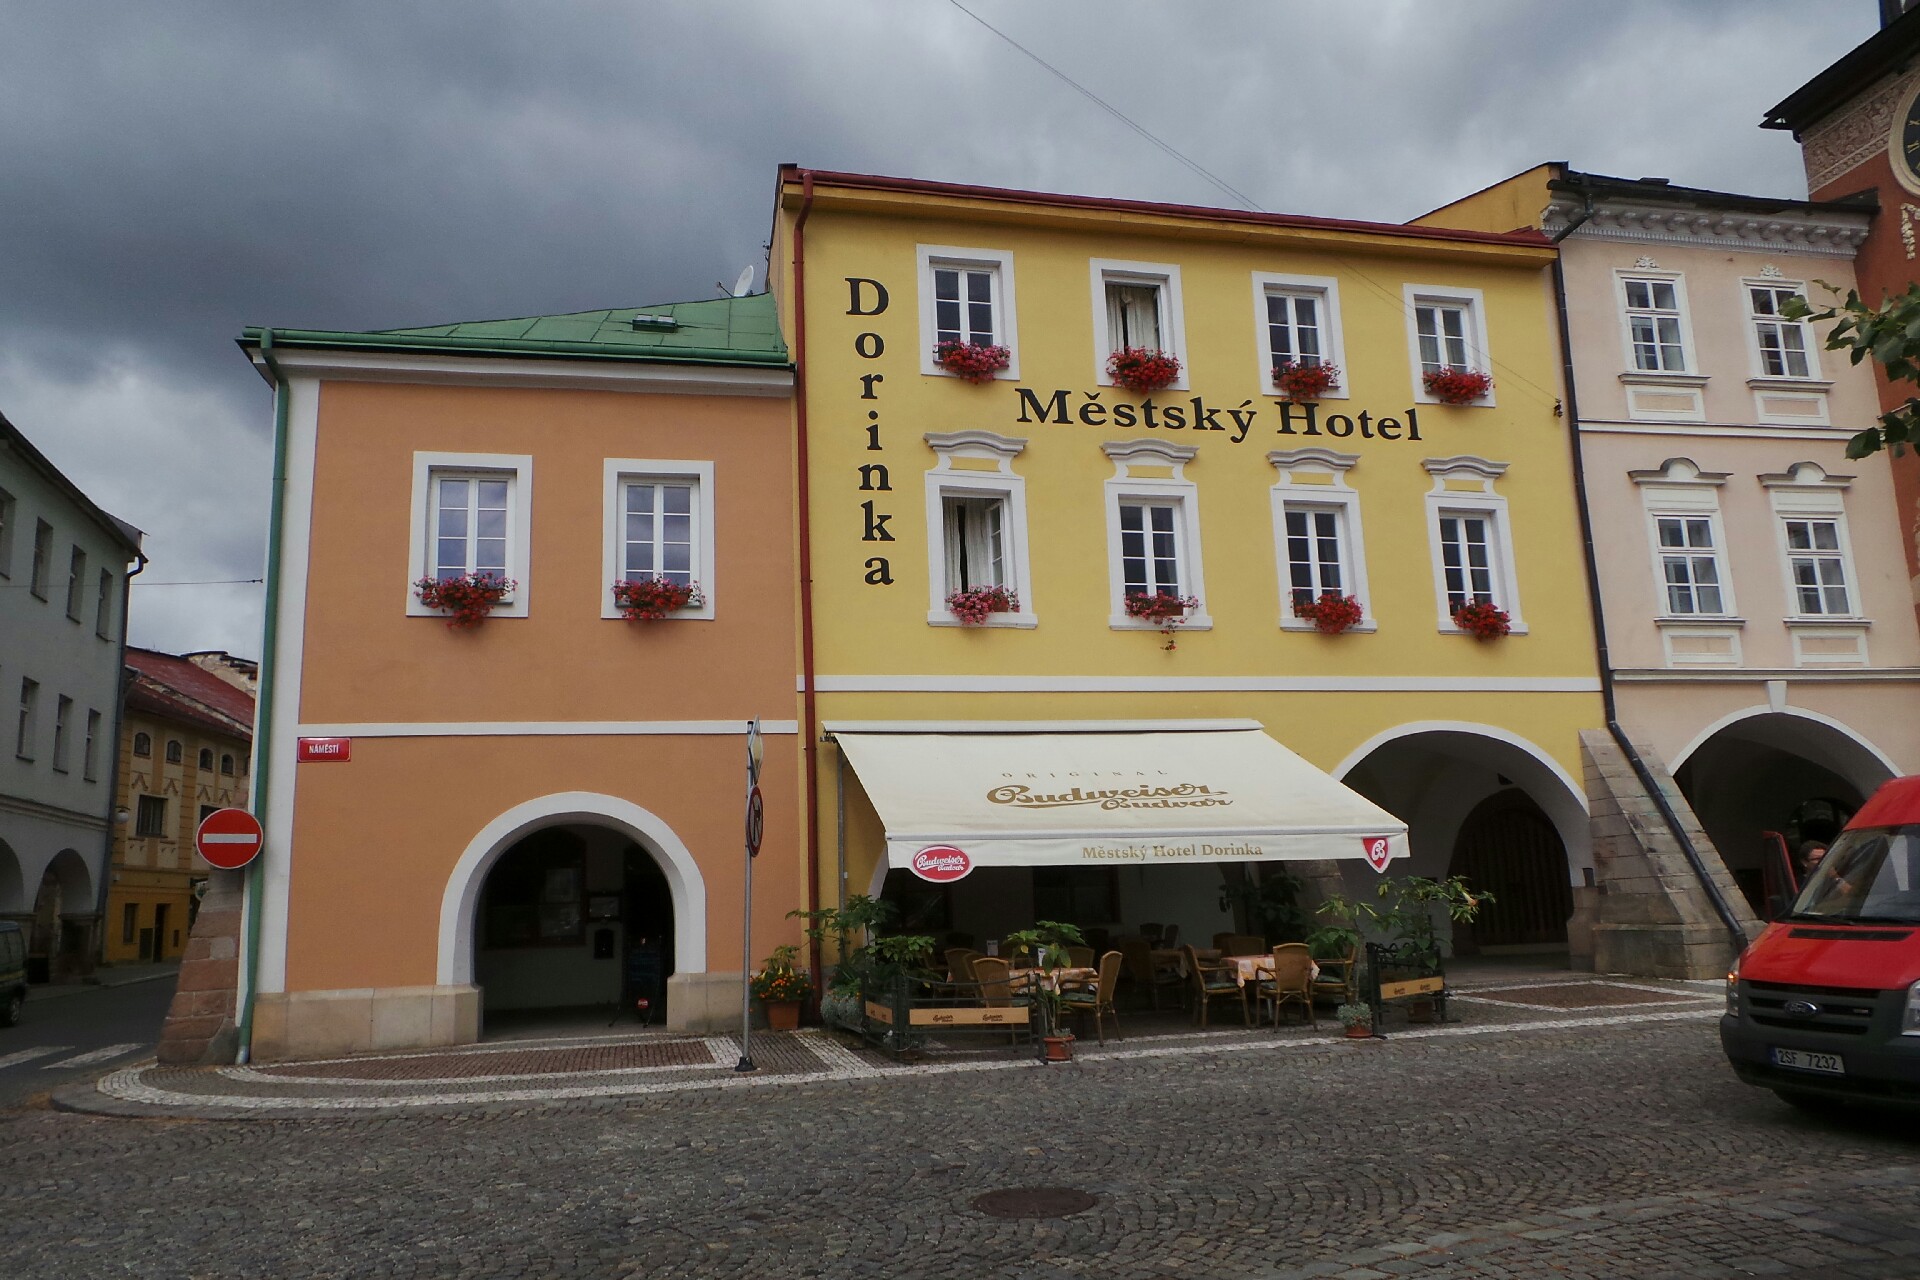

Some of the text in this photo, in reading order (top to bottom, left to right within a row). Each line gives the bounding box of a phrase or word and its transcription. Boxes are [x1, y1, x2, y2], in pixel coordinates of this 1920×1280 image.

[1014, 387, 1423, 444] Městský Hotel
[844, 277, 896, 586] Dorinka
[986, 783, 1229, 808] Budweiser
[1100, 797, 1234, 811] Budvar
[1082, 842, 1264, 861] Městský Hotel Dorinka
[916, 854, 966, 870] Budweiser
[1806, 1053, 1839, 1070] 7232
